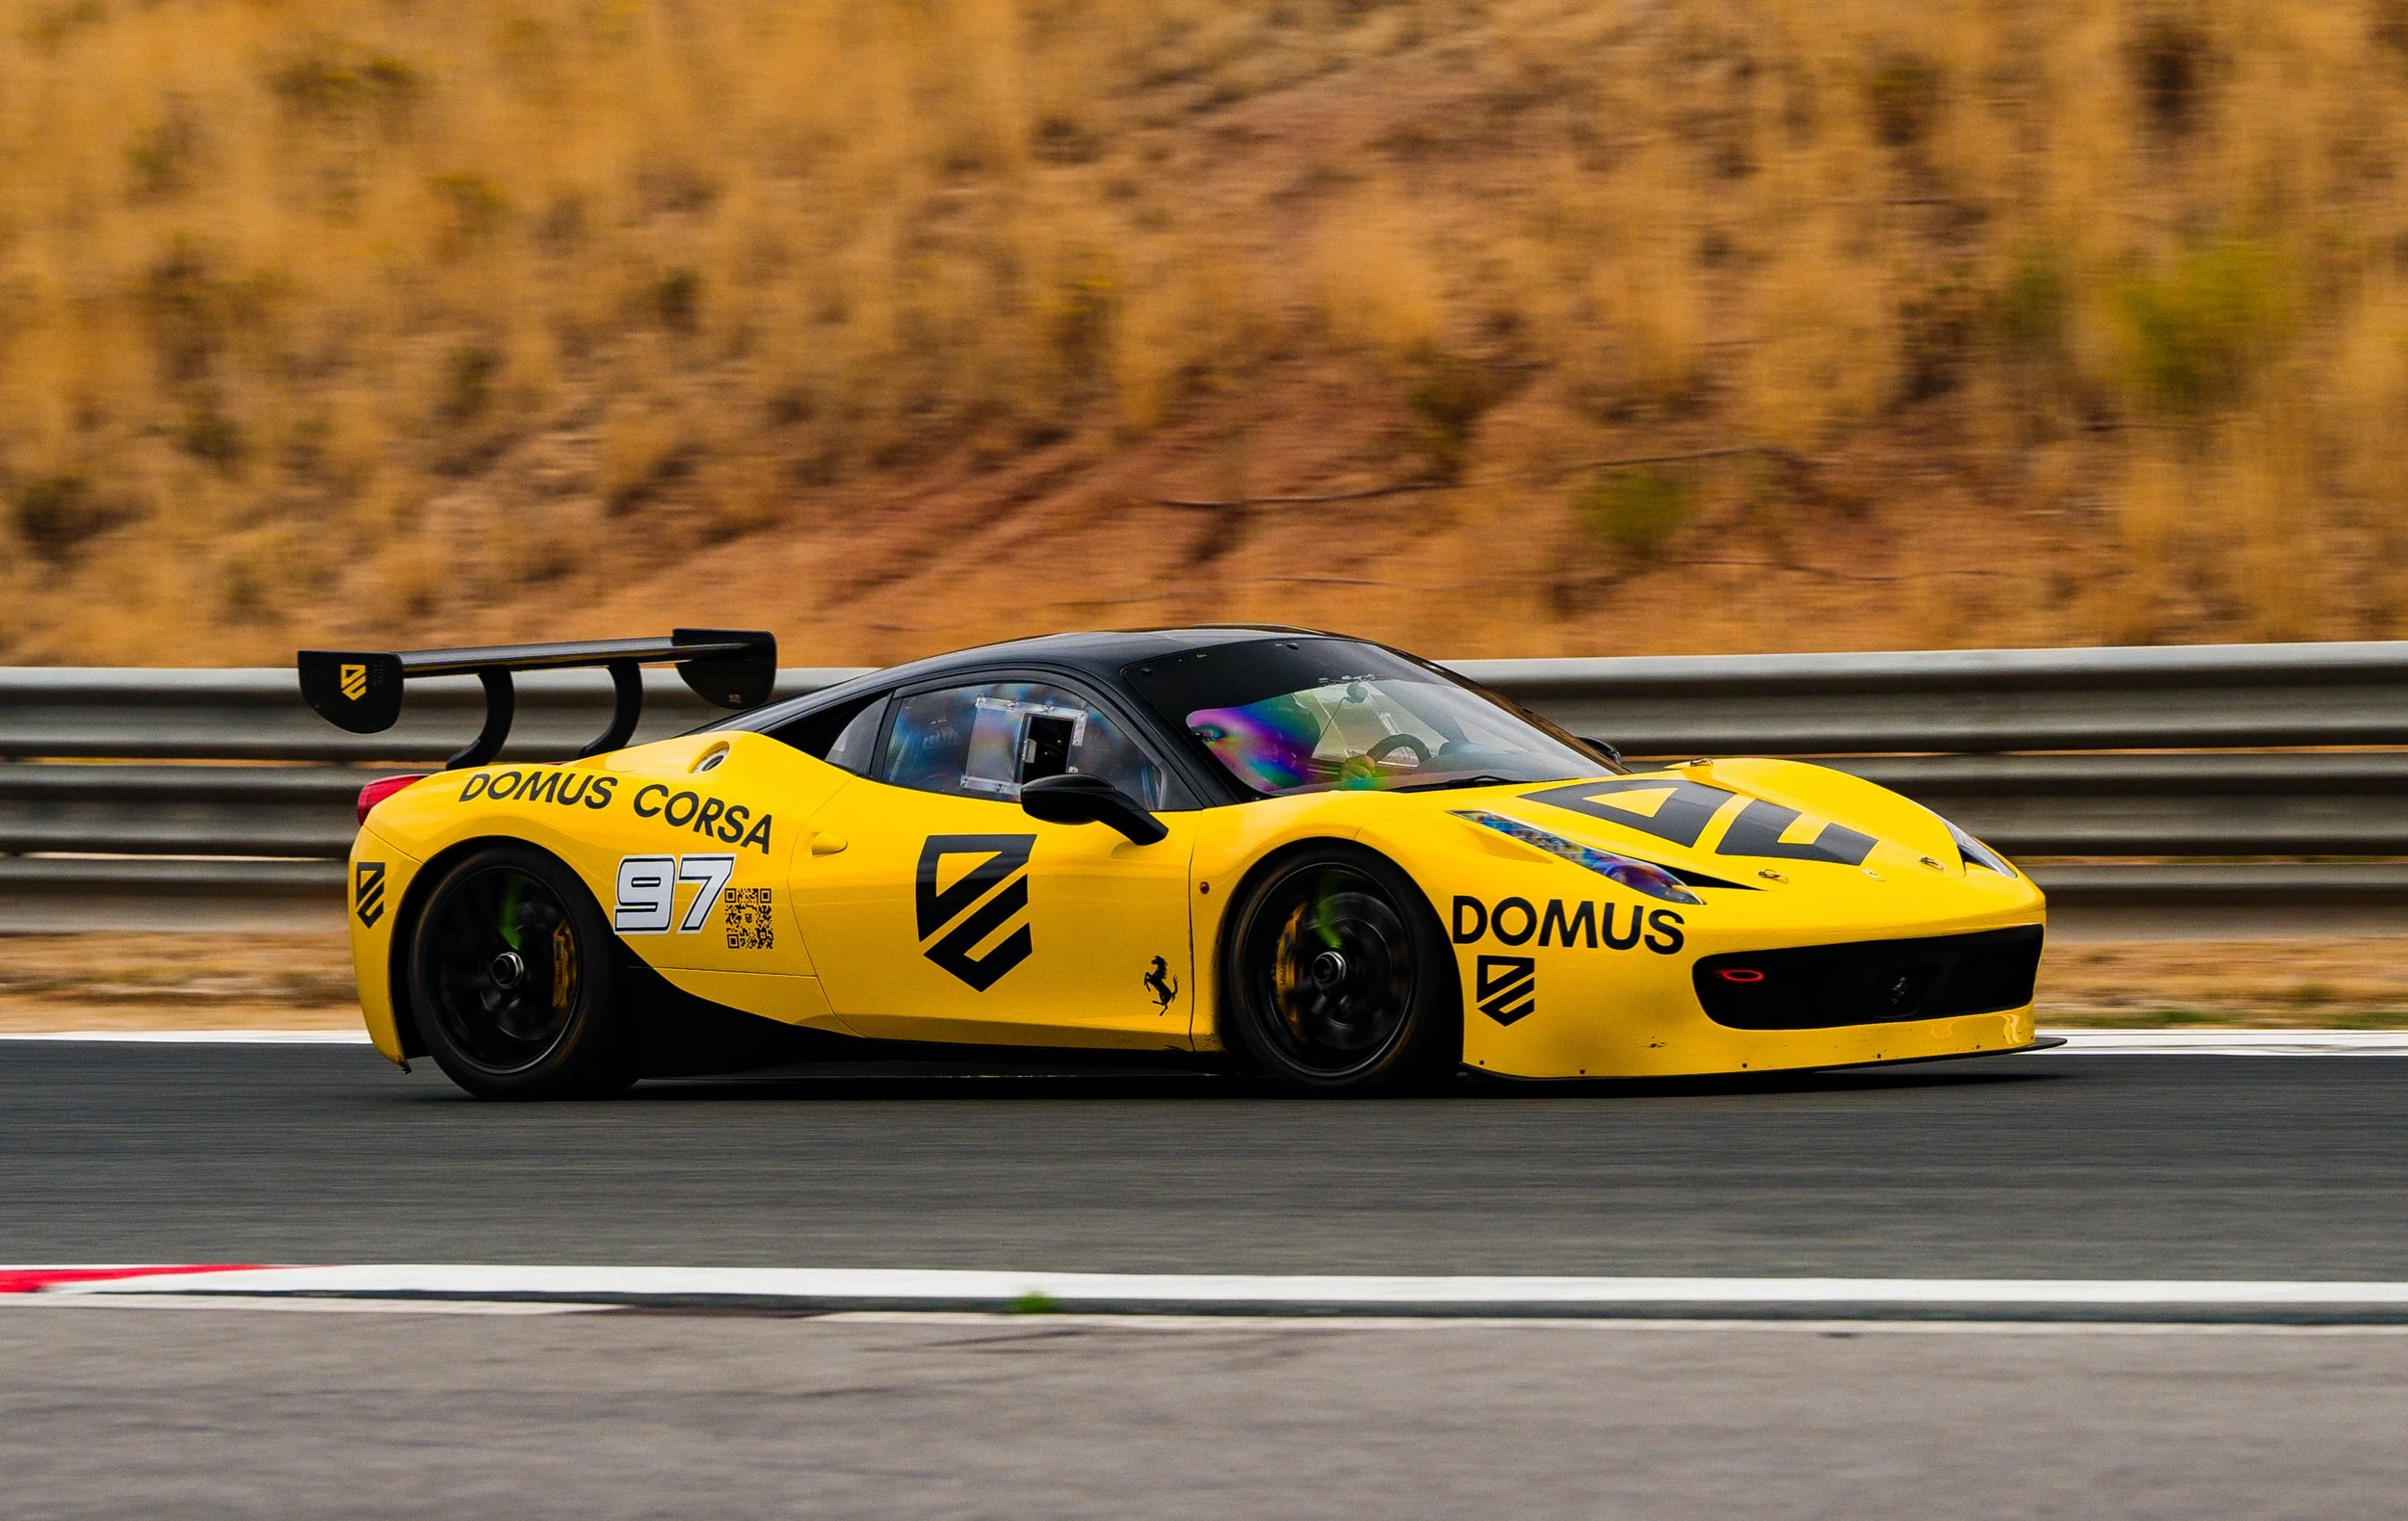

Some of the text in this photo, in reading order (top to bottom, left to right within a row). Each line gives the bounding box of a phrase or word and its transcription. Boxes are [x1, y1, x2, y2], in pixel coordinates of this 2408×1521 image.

[458, 771, 772, 854] DOMUS CORSA
[614, 853, 737, 934] 97
[1452, 895, 1685, 956] DOMUS
